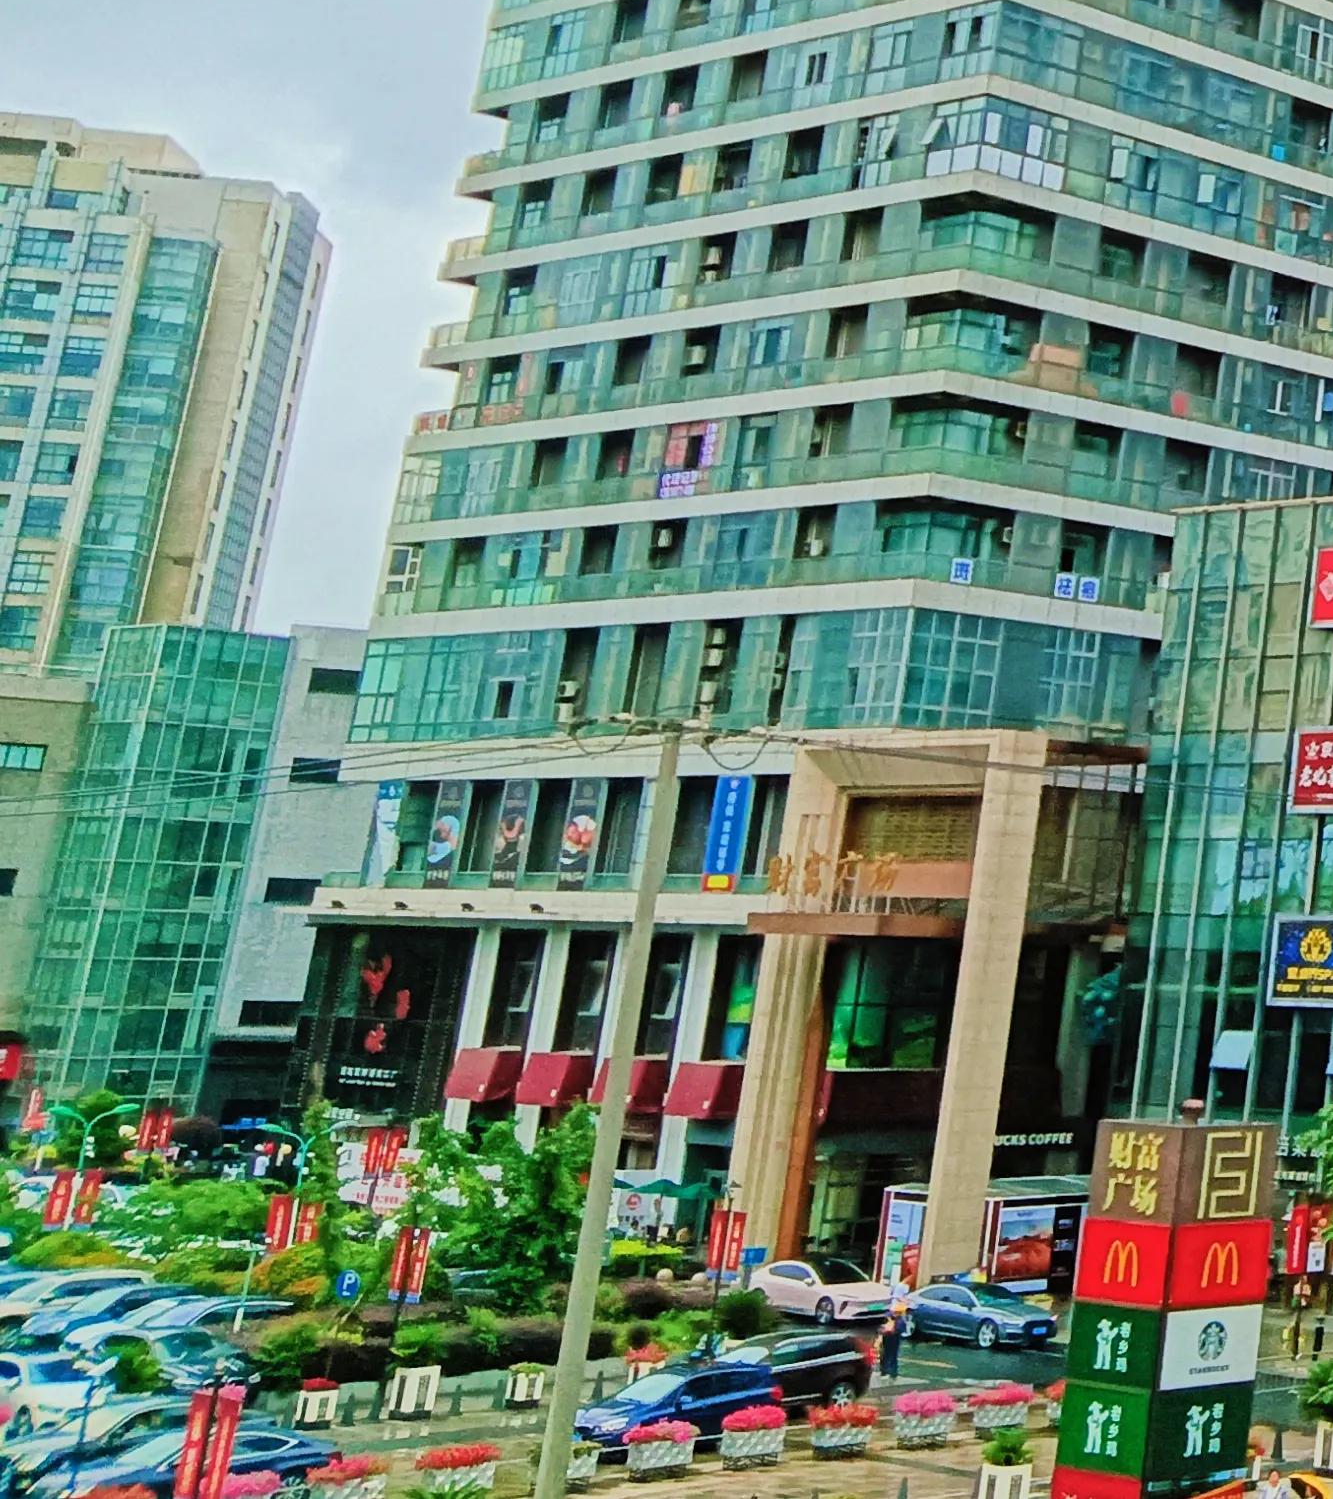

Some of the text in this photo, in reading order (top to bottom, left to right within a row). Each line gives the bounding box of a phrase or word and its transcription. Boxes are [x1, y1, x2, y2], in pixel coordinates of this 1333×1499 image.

[1028, 1132, 1074, 1146] COFFEE
[1107, 1131, 1166, 1172] 财富
[1102, 1173, 1158, 1216] 广场
